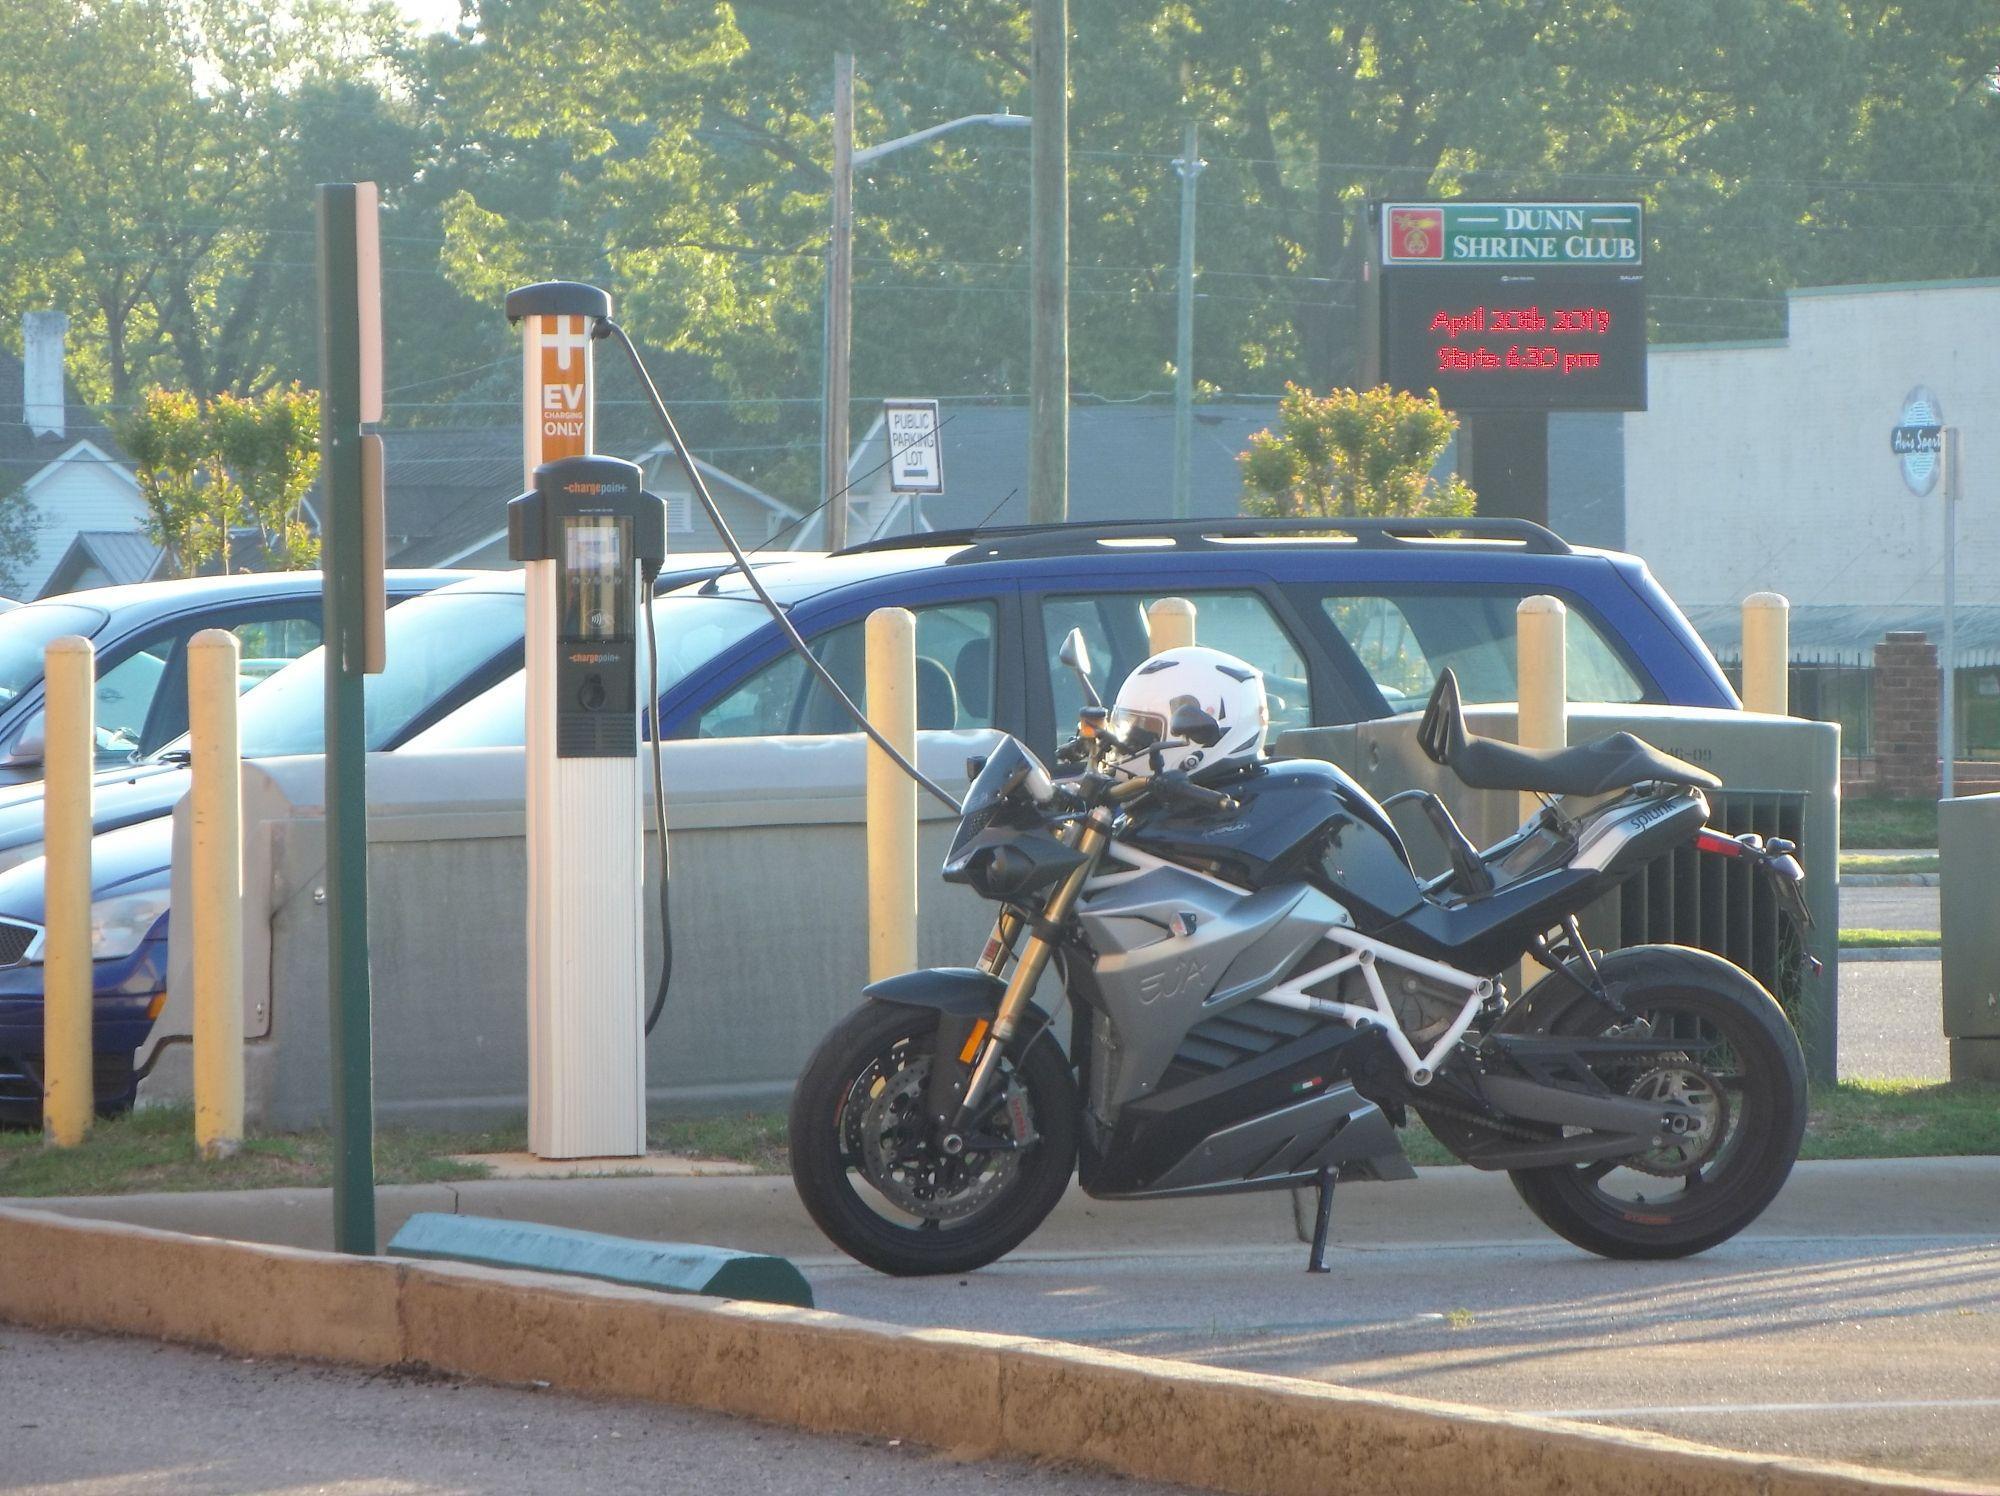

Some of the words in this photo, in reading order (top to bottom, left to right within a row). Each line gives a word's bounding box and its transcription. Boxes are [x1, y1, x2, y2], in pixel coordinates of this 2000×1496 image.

[1505, 208, 1584, 231] DUNN
[1453, 236, 1557, 258] SHRINE
[1565, 236, 1636, 258] CLUB
[1430, 305, 1485, 338] April
[1490, 305, 1546, 331] 20th
[1552, 307, 1610, 333] 2019
[1564, 354, 1600, 374] pm
[544, 383, 583, 410] EV
[544, 411, 583, 419] CHARGING
[894, 413, 930, 430] PUBLIC
[544, 421, 584, 436] ONLY
[892, 432, 934, 448] PARKING
[905, 451, 923, 466] LOT
[1630, 799, 1678, 832] splunk
